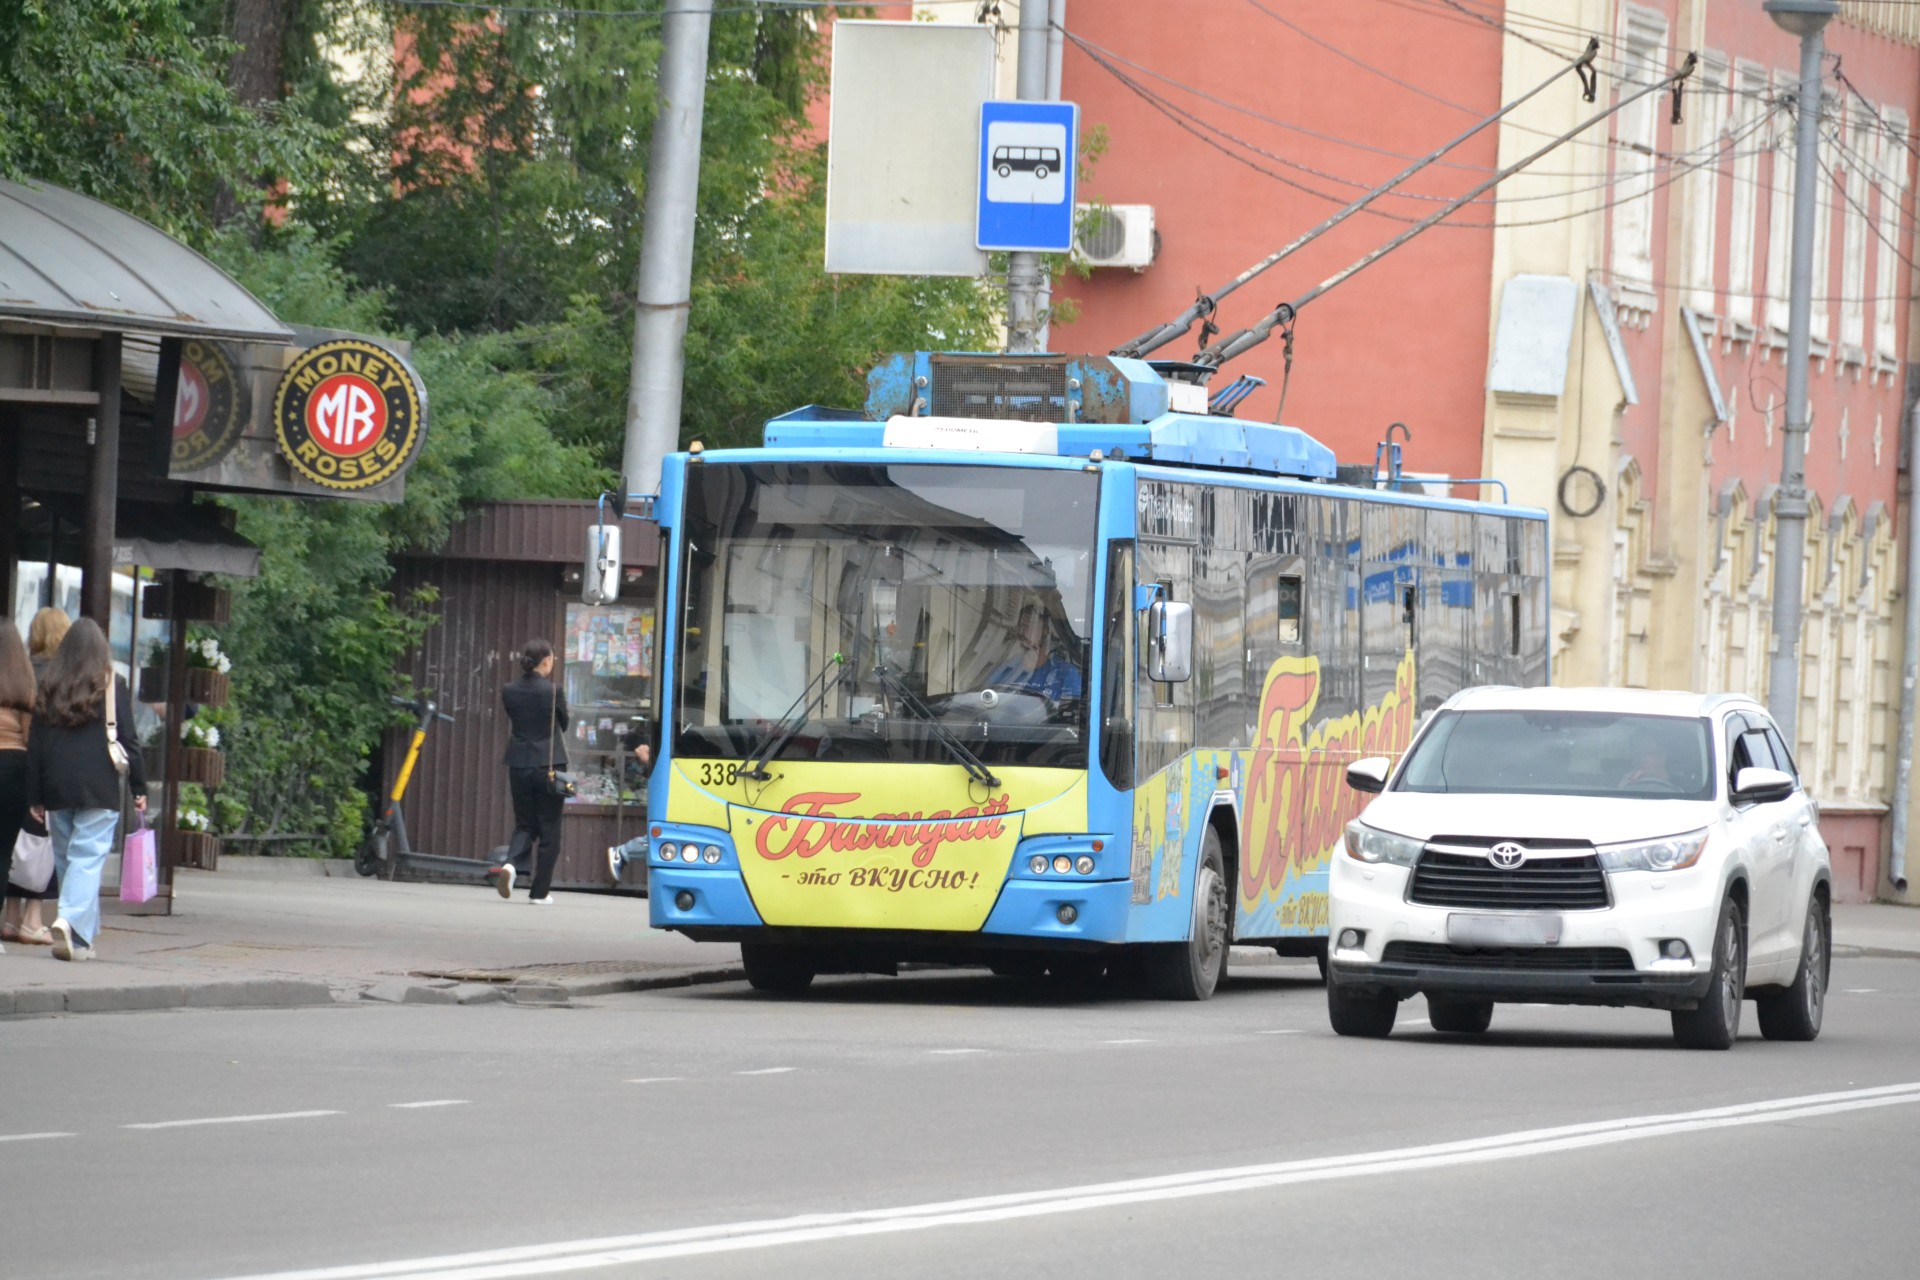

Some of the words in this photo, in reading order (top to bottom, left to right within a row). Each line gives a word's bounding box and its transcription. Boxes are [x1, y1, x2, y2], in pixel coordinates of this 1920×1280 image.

[294, 352, 401, 393] MONEY
[316, 384, 376, 446] MR
[296, 437, 397, 479] ROSES
[700, 762, 738, 786] 338
[755, 792, 1010, 868] Баяндай
[797, 868, 843, 886] это
[849, 867, 980, 892] ВКУСНО!
